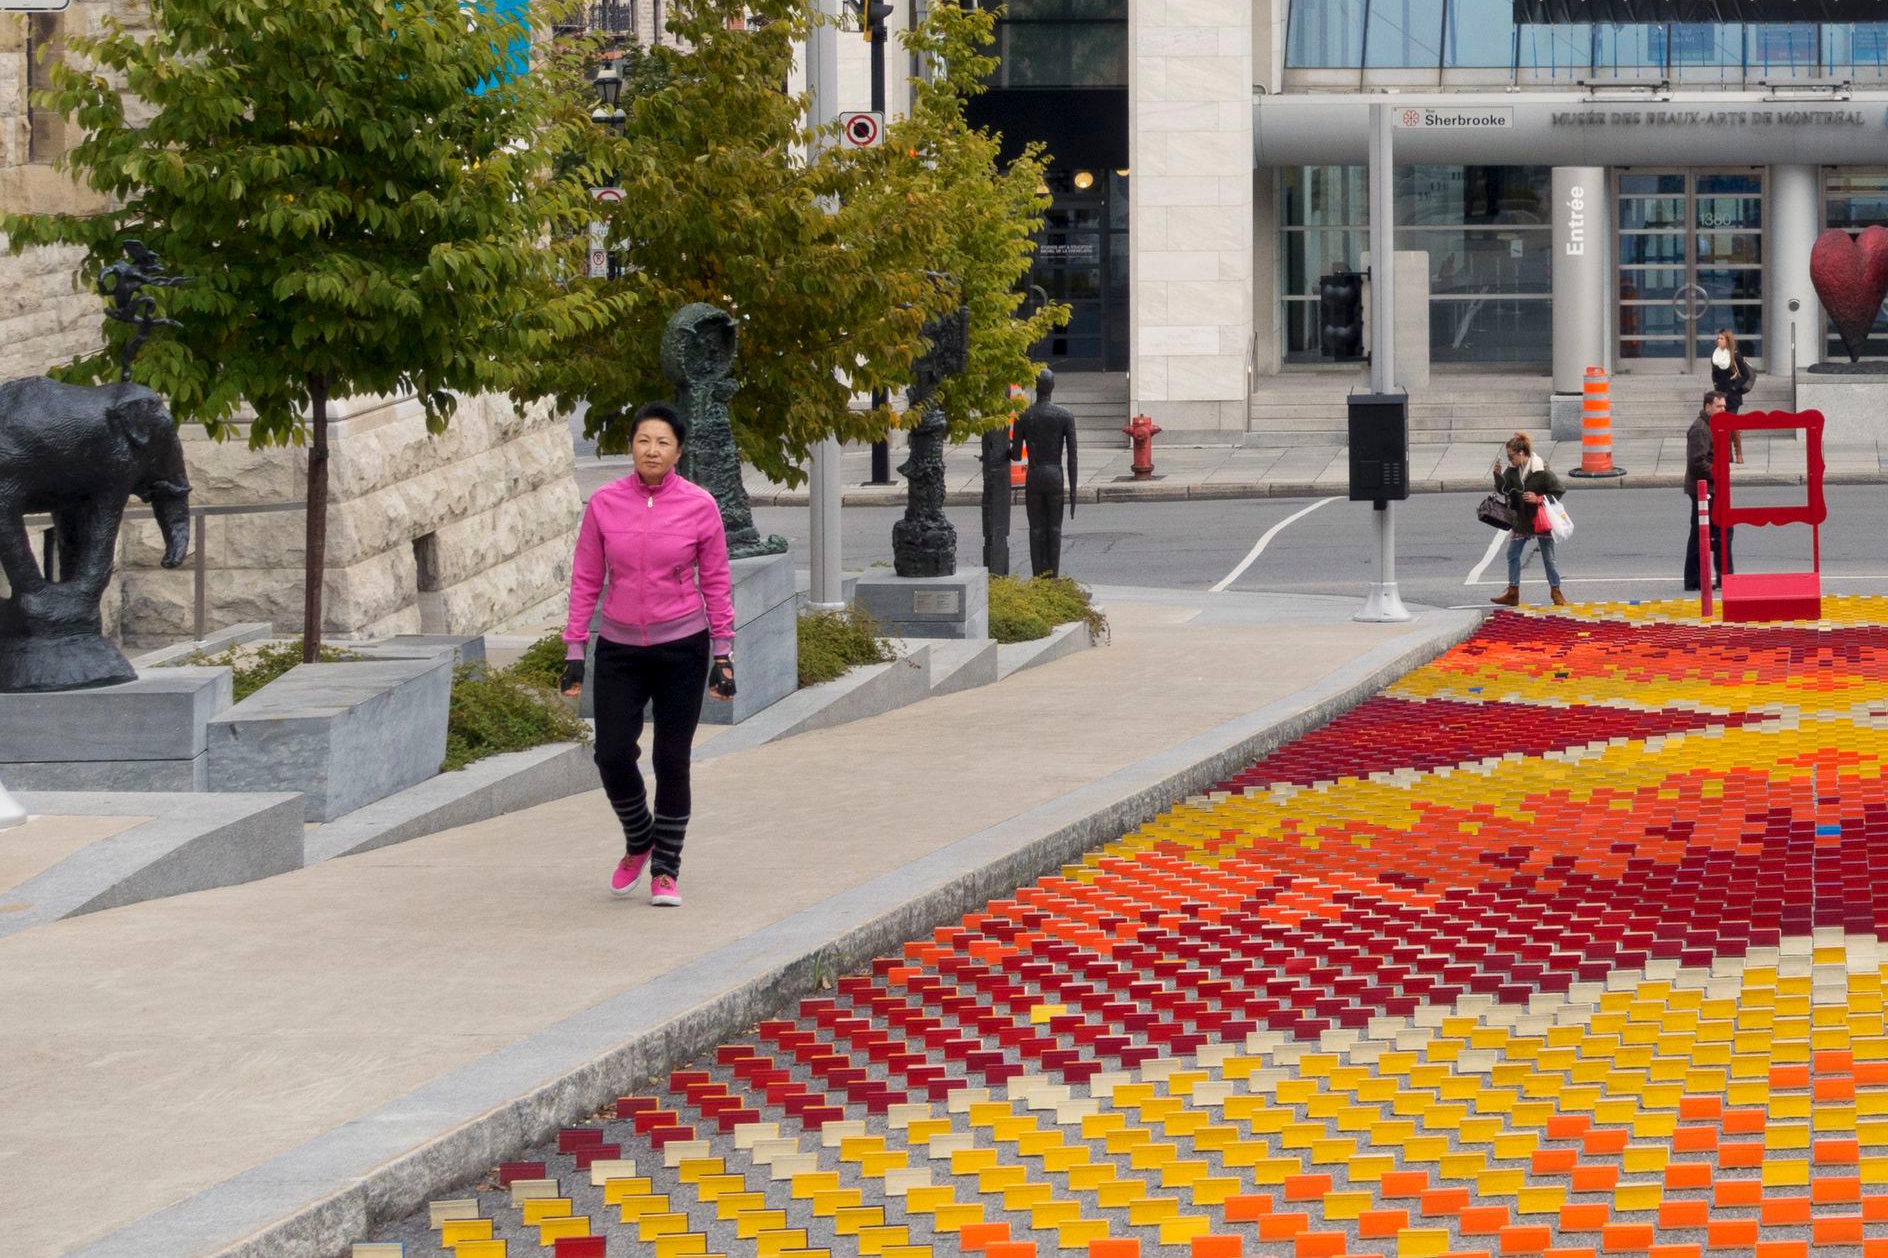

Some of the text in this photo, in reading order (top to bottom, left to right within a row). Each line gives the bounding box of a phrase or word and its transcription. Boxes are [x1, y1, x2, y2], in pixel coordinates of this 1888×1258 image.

[1424, 114, 1506, 127] Sherbrooke
[1610, 111, 1641, 127] DES
[1647, 111, 1746, 126] BEAUX-ARTS
[1751, 111, 1772, 126] DE
[1566, 185, 1585, 256] Entrée
[1700, 213, 1732, 227] 1380
